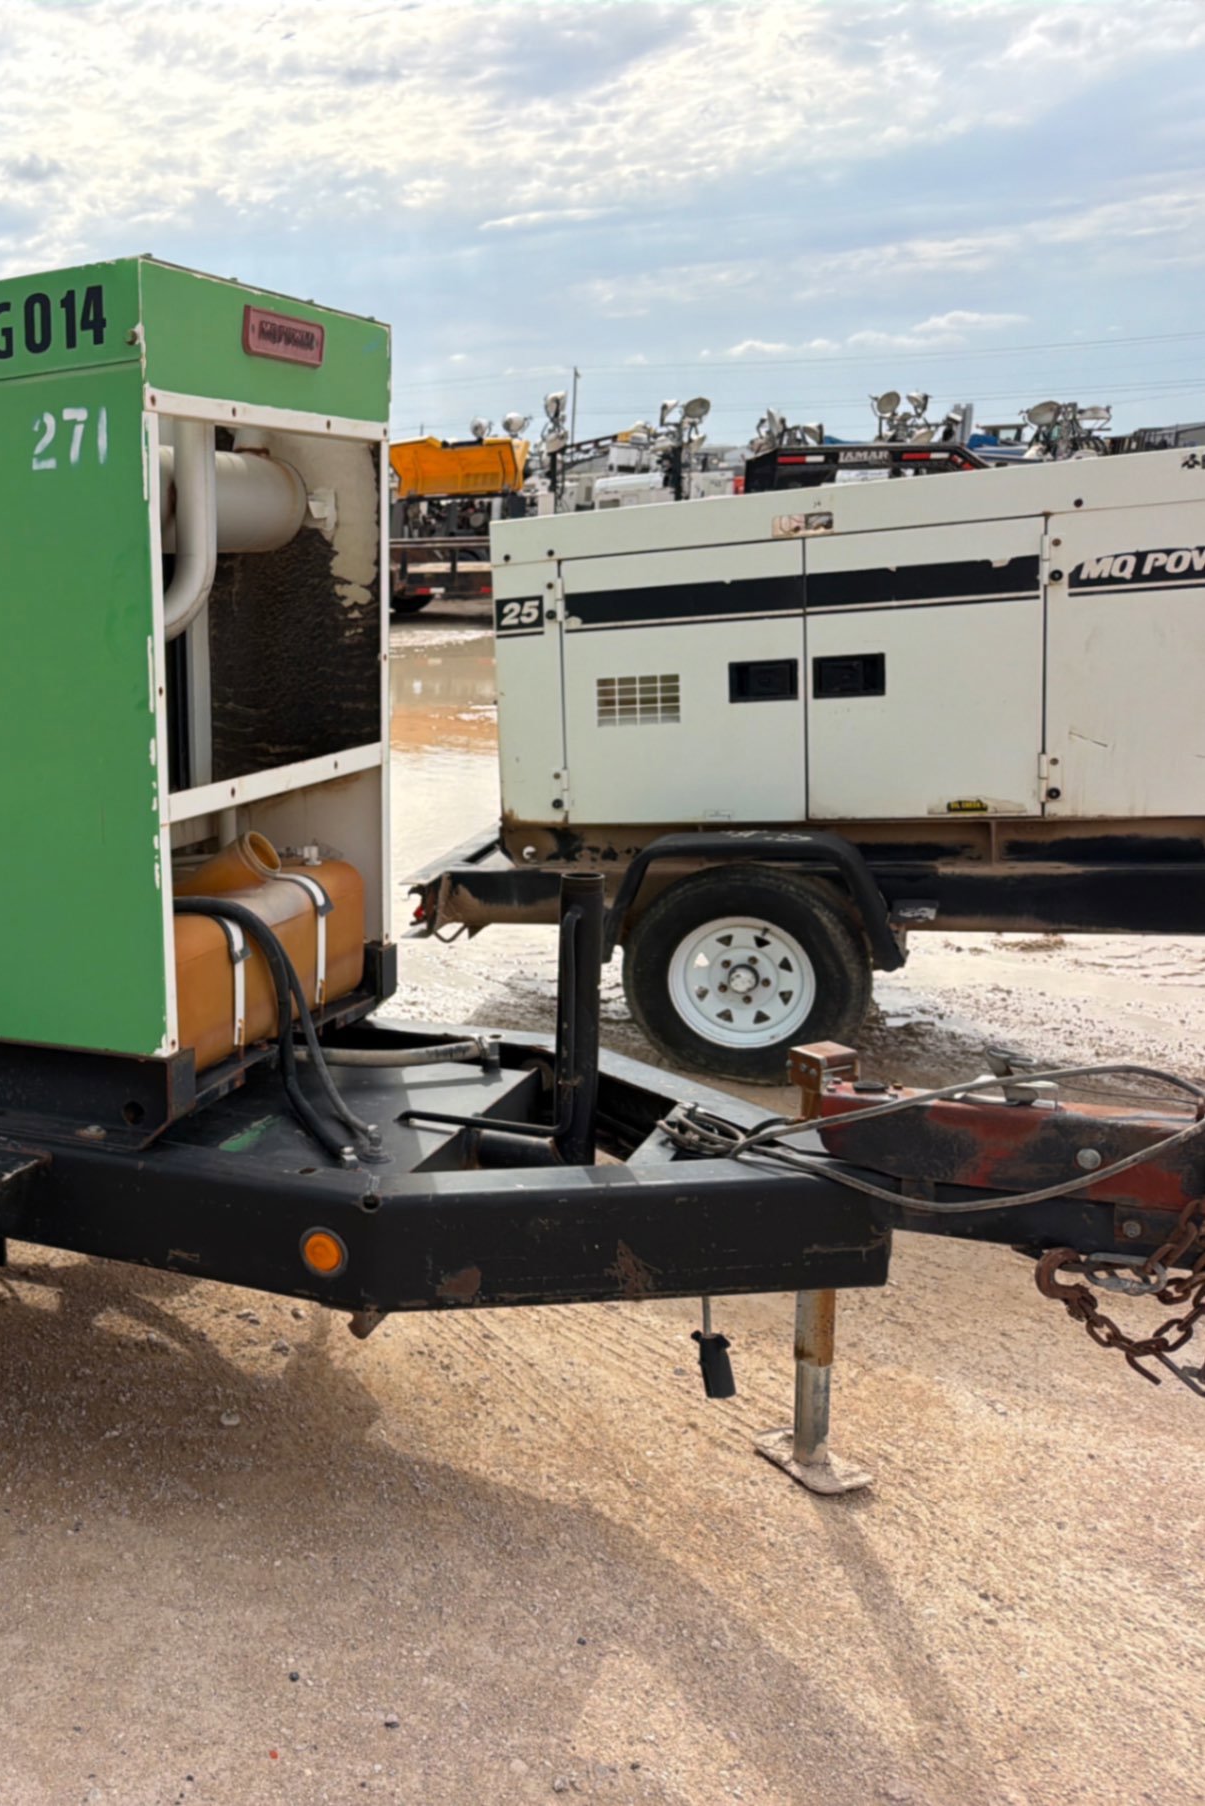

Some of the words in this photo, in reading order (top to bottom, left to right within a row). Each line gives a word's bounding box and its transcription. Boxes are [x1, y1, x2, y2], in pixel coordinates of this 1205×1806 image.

[31, 406, 108, 471] 271
[838, 450, 890, 464] LAMAR
[1079, 554, 1137, 580] MQ
[500, 600, 540, 626] 25
